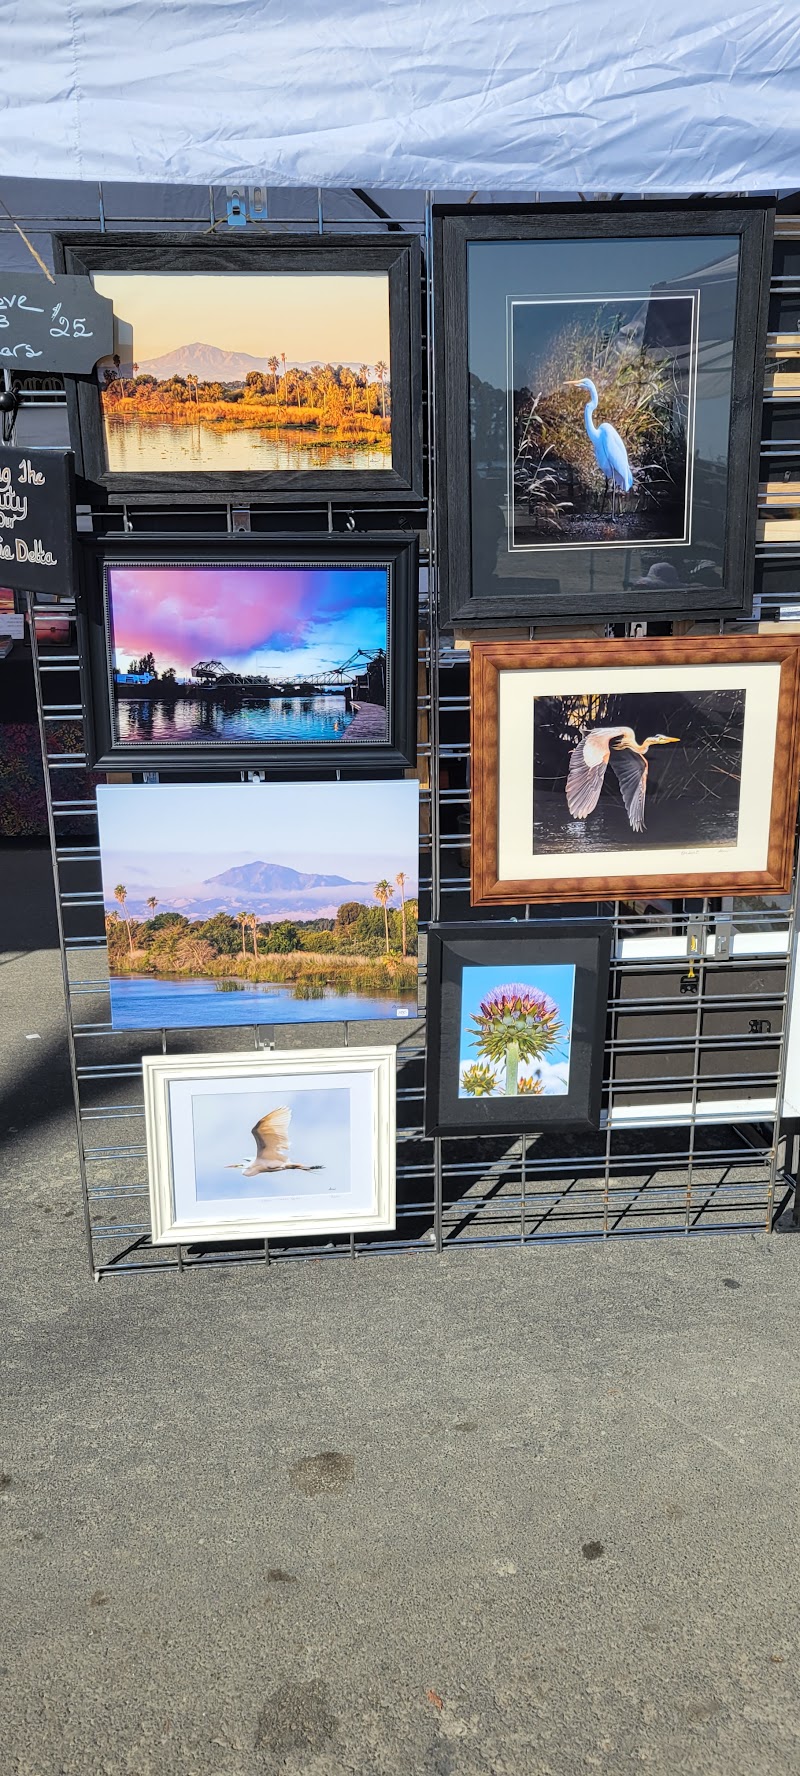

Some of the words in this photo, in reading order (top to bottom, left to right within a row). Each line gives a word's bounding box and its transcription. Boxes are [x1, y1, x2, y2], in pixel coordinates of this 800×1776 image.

[49, 302, 94, 338] $25
[18, 459, 45, 485] The
[15, 538, 58, 566] Delta
